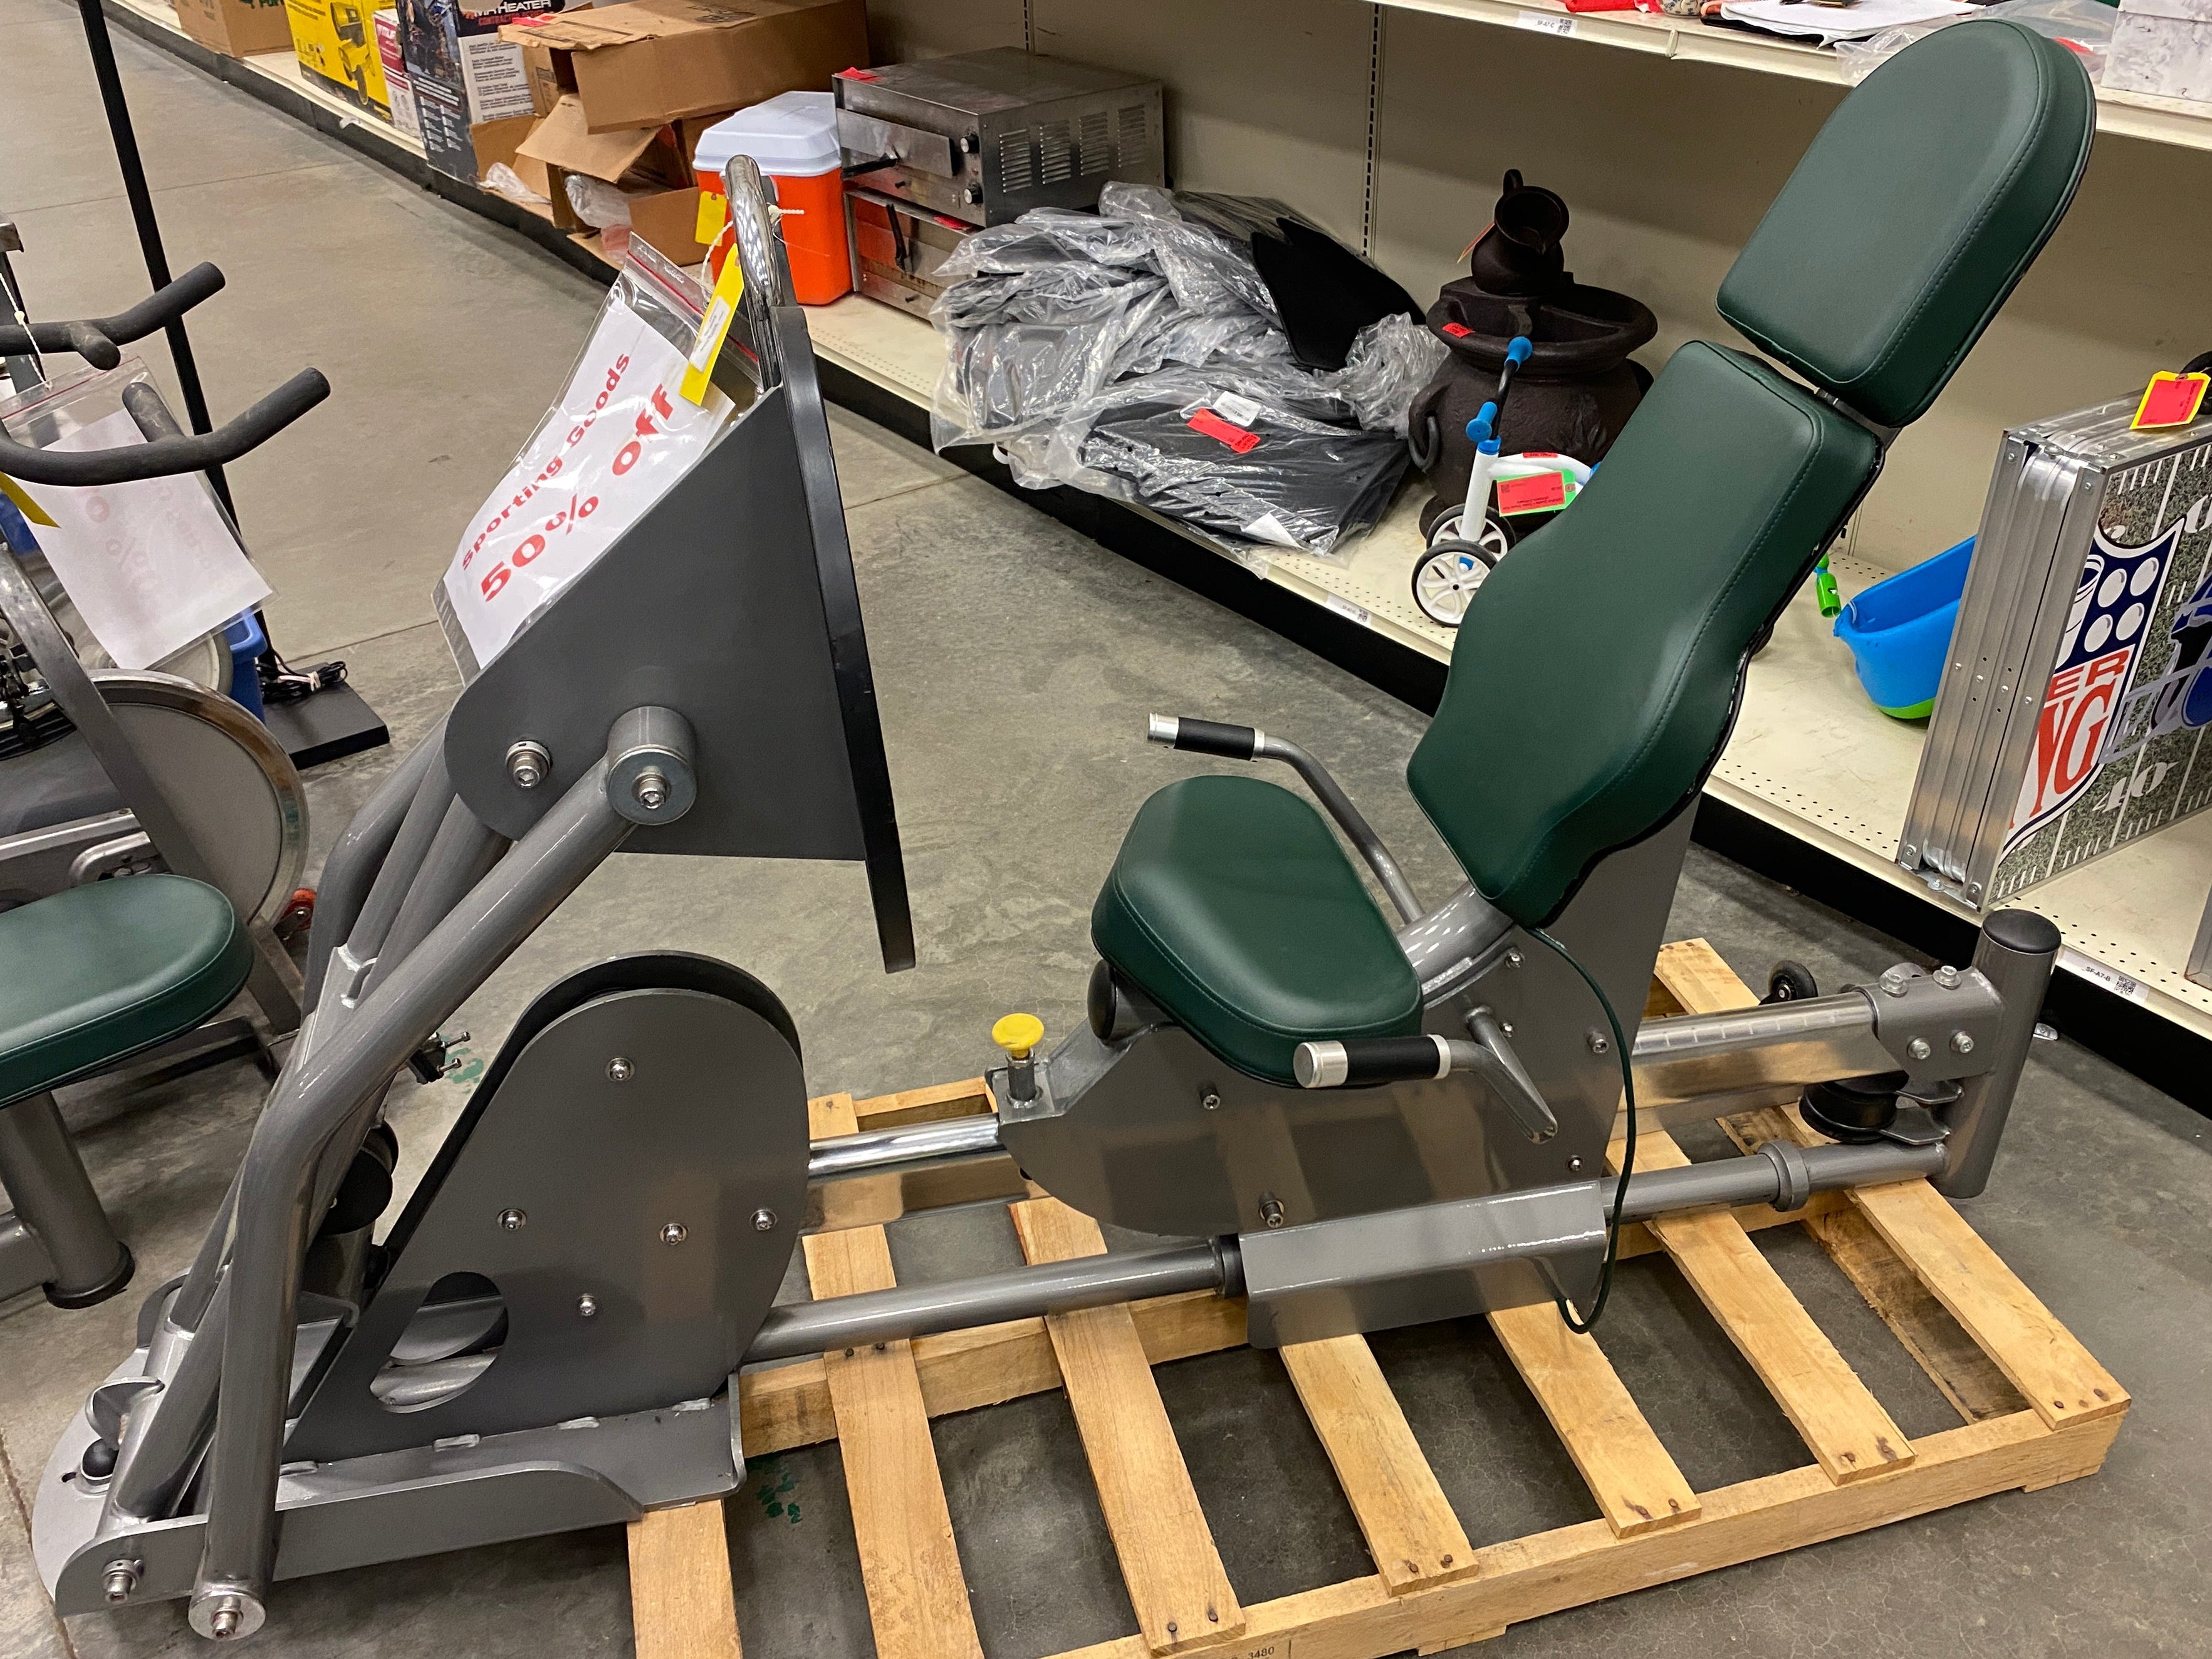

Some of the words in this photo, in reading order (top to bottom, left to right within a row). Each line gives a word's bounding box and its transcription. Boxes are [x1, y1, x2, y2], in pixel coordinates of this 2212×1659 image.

[566, 353, 630, 447] Goods
[480, 495, 599, 601] 50%
[2092, 761, 2179, 813] 40
[1248, 1646, 1275, 1659] 3480
